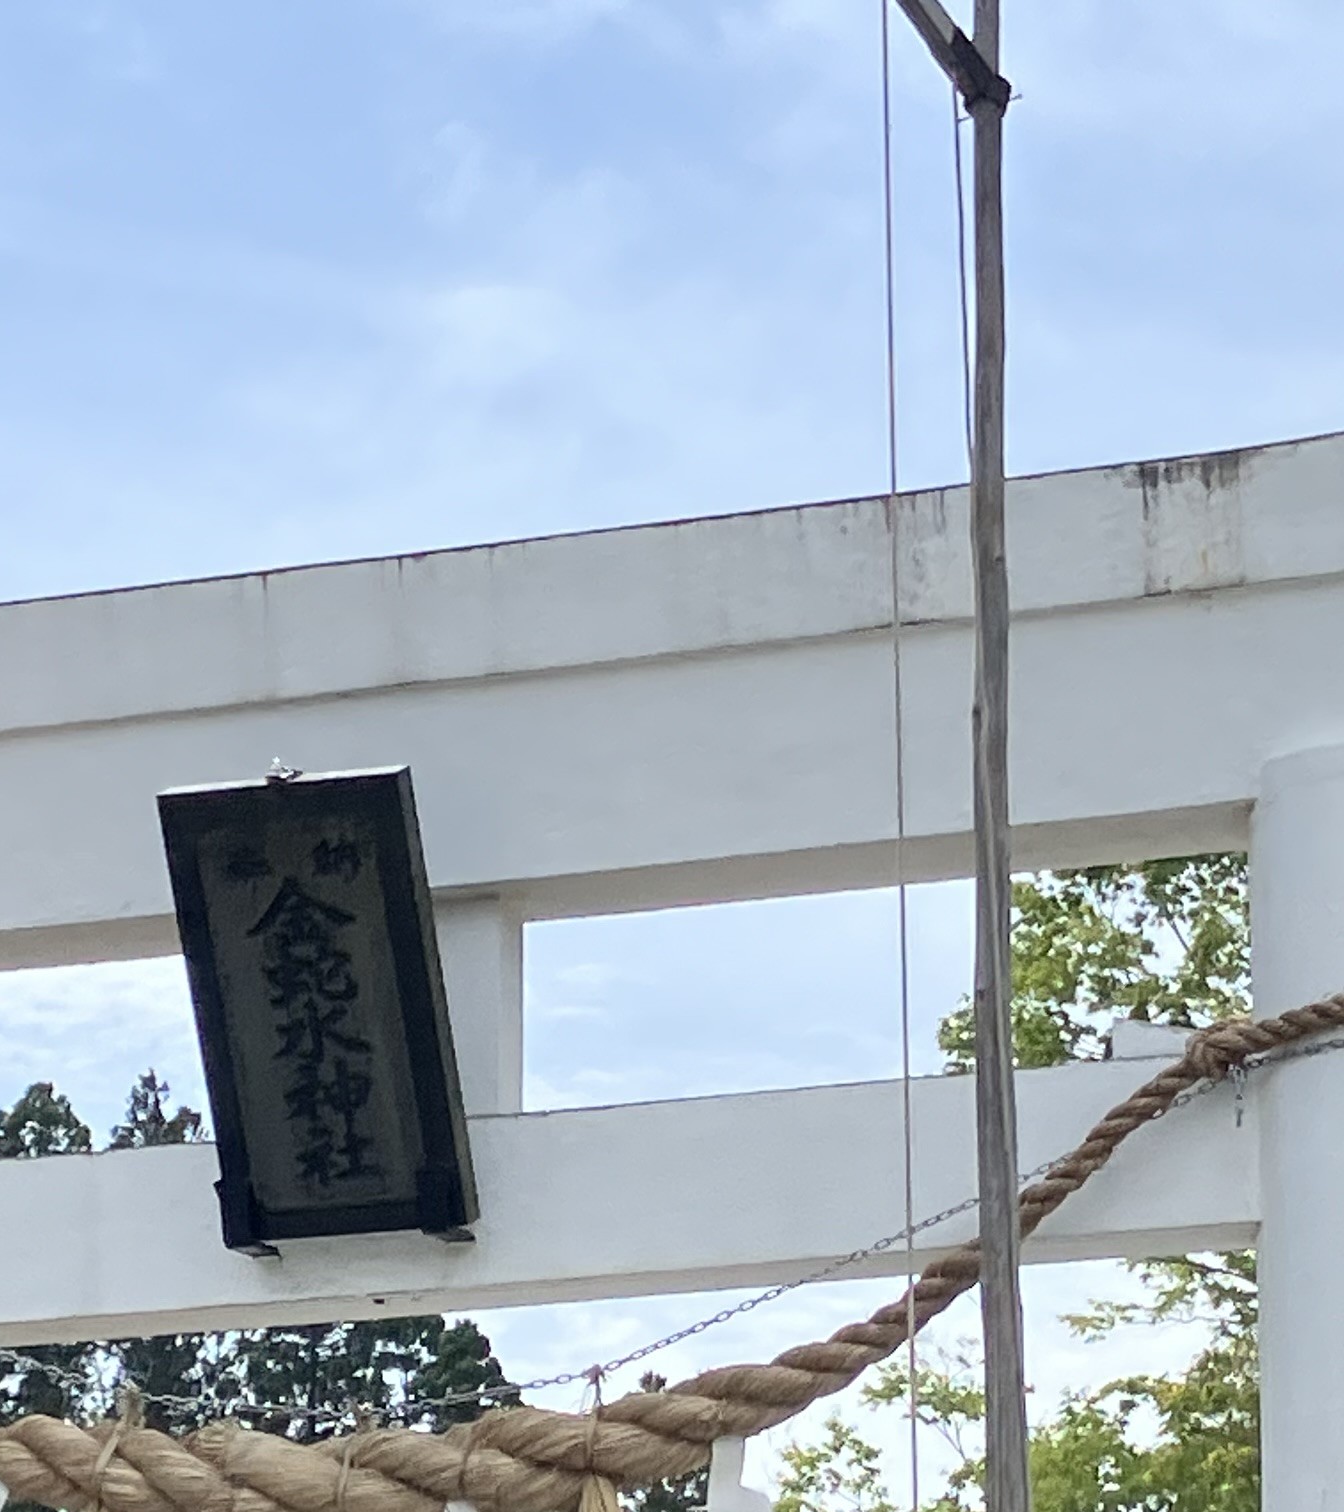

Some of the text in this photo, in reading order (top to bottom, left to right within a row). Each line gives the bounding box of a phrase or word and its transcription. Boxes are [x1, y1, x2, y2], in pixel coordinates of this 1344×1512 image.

[247, 875, 387, 1188] 金蛇水神社
